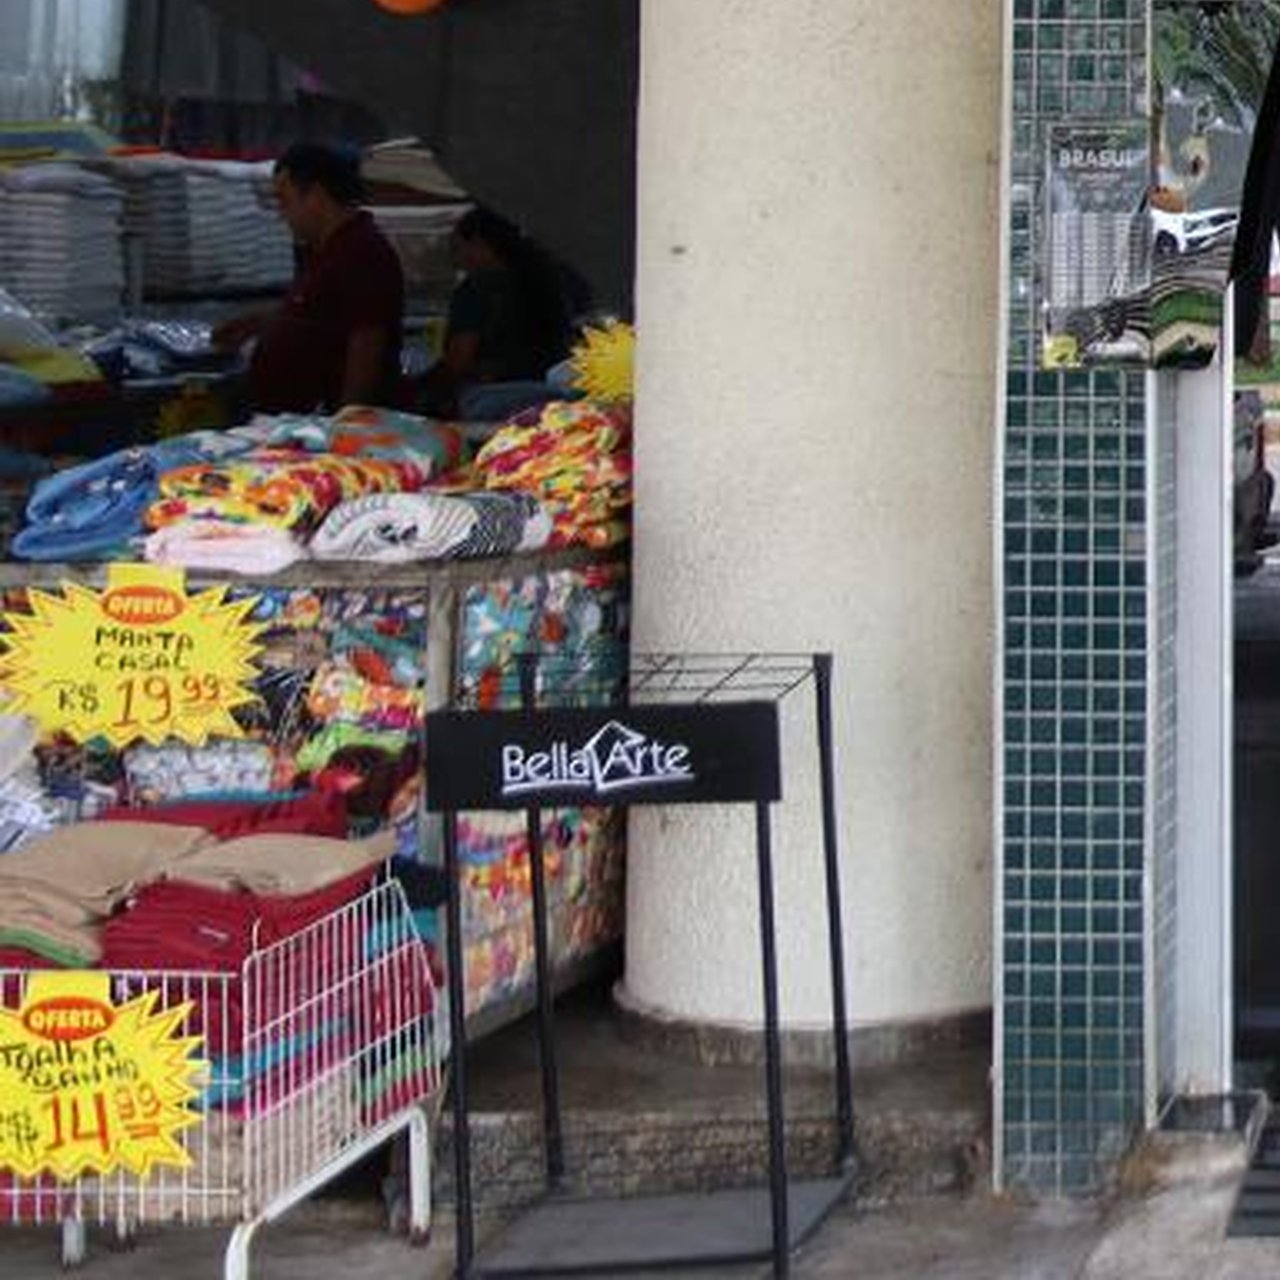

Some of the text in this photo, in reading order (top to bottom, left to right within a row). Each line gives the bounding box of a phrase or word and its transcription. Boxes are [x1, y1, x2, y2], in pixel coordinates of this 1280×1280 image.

[95, 627, 194, 651] MANTA
[95, 651, 189, 671] CASAL
[28, 1009, 107, 1028] OFERTA
